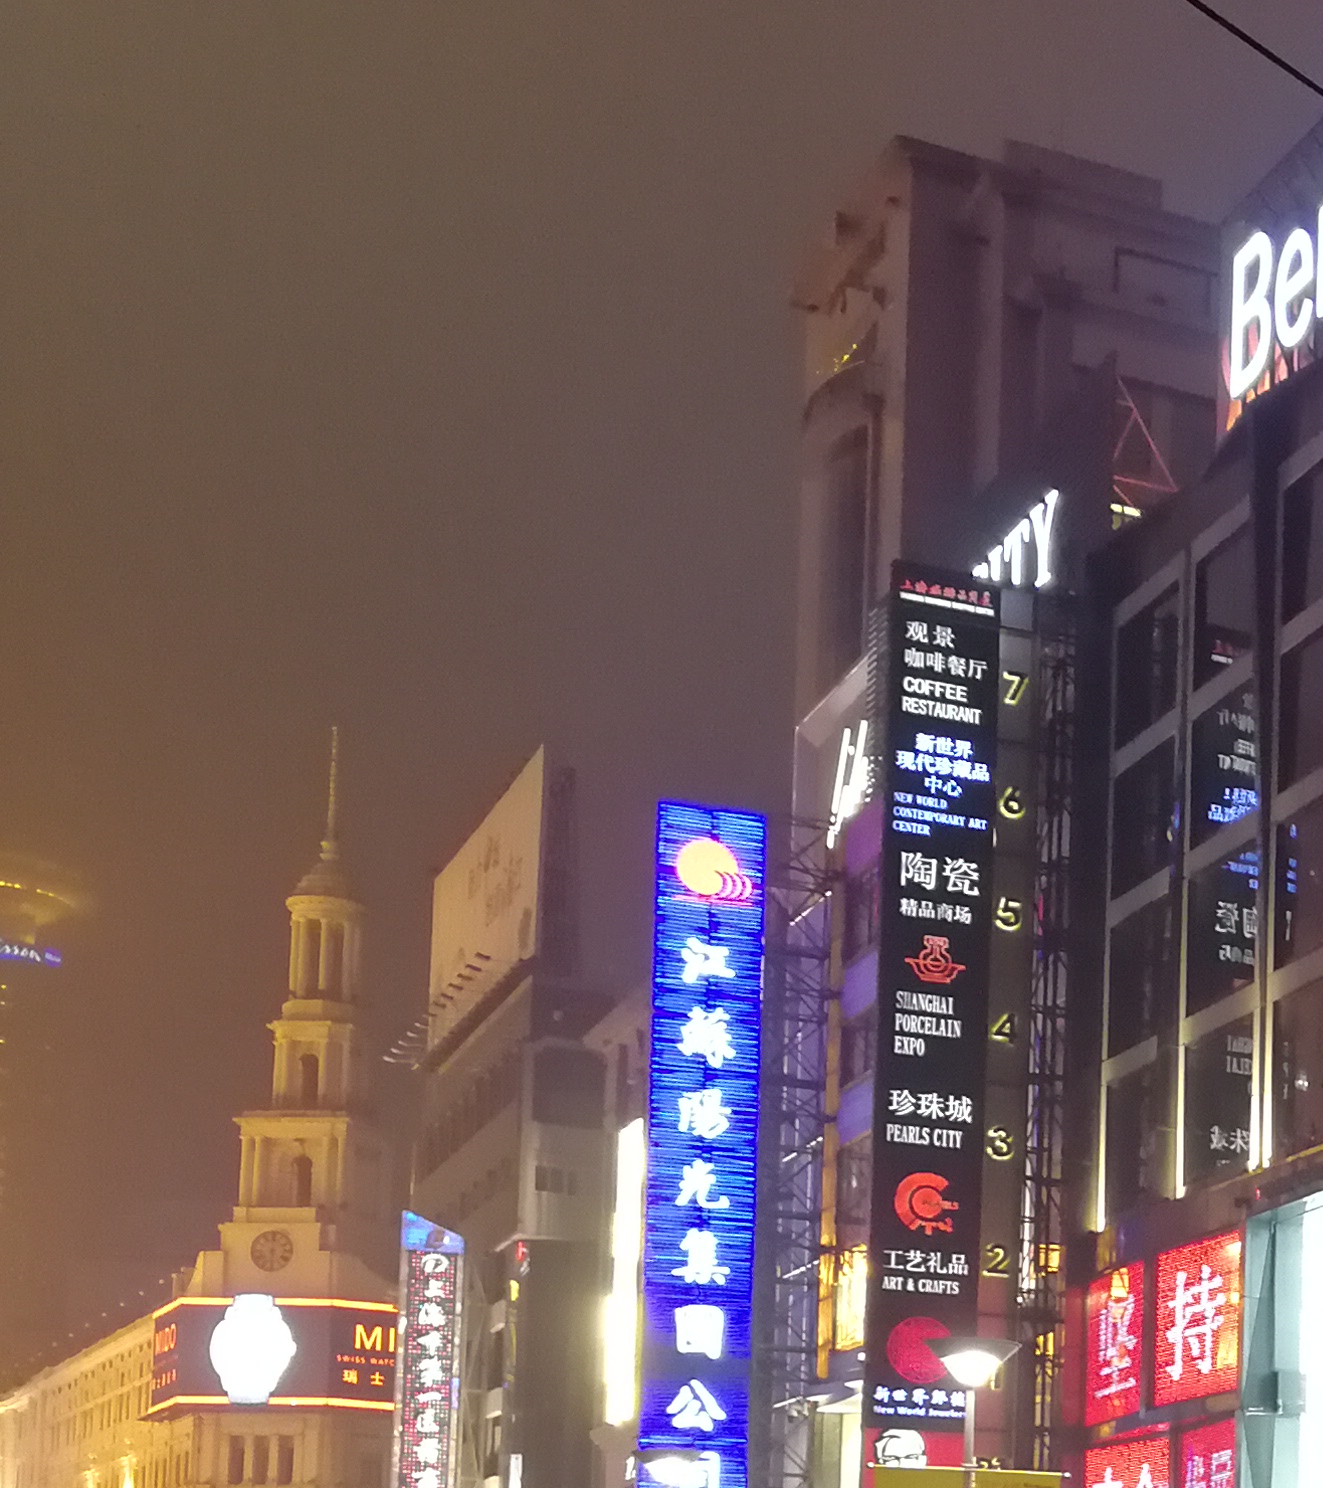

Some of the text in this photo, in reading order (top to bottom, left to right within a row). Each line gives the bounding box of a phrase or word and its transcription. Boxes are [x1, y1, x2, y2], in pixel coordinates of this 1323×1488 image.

[905, 621, 956, 649] 观景
[904, 647, 988, 680] 咖啡餐厅
[903, 676, 968, 702] COFFEE
[1002, 671, 1029, 706] 7
[902, 696, 982, 725] RESTAURANT
[915, 733, 974, 759] 新世界
[893, 792, 948, 810] NEW WORLD
[924, 777, 963, 798] 中心
[998, 786, 1026, 820] 6
[893, 806, 988, 831] CONTEMPORARY ART
[893, 821, 931, 837] CENTER
[900, 851, 980, 897] 陶瓷
[899, 898, 973, 925] 精品商场
[994, 897, 1023, 932] 5
[896, 991, 954, 1016] SHANGHAI
[895, 1013, 961, 1038] PORCELAIN
[894, 1036, 925, 1057] EXPO
[888, 1089, 973, 1124] 珍珠城
[886, 1123, 963, 1150] PEARLS CITY
[986, 1124, 1014, 1161] 3
[882, 1249, 969, 1276] 工艺礼品
[982, 1244, 1011, 1278] 2
[882, 1276, 960, 1296] ART & CRAFTS
